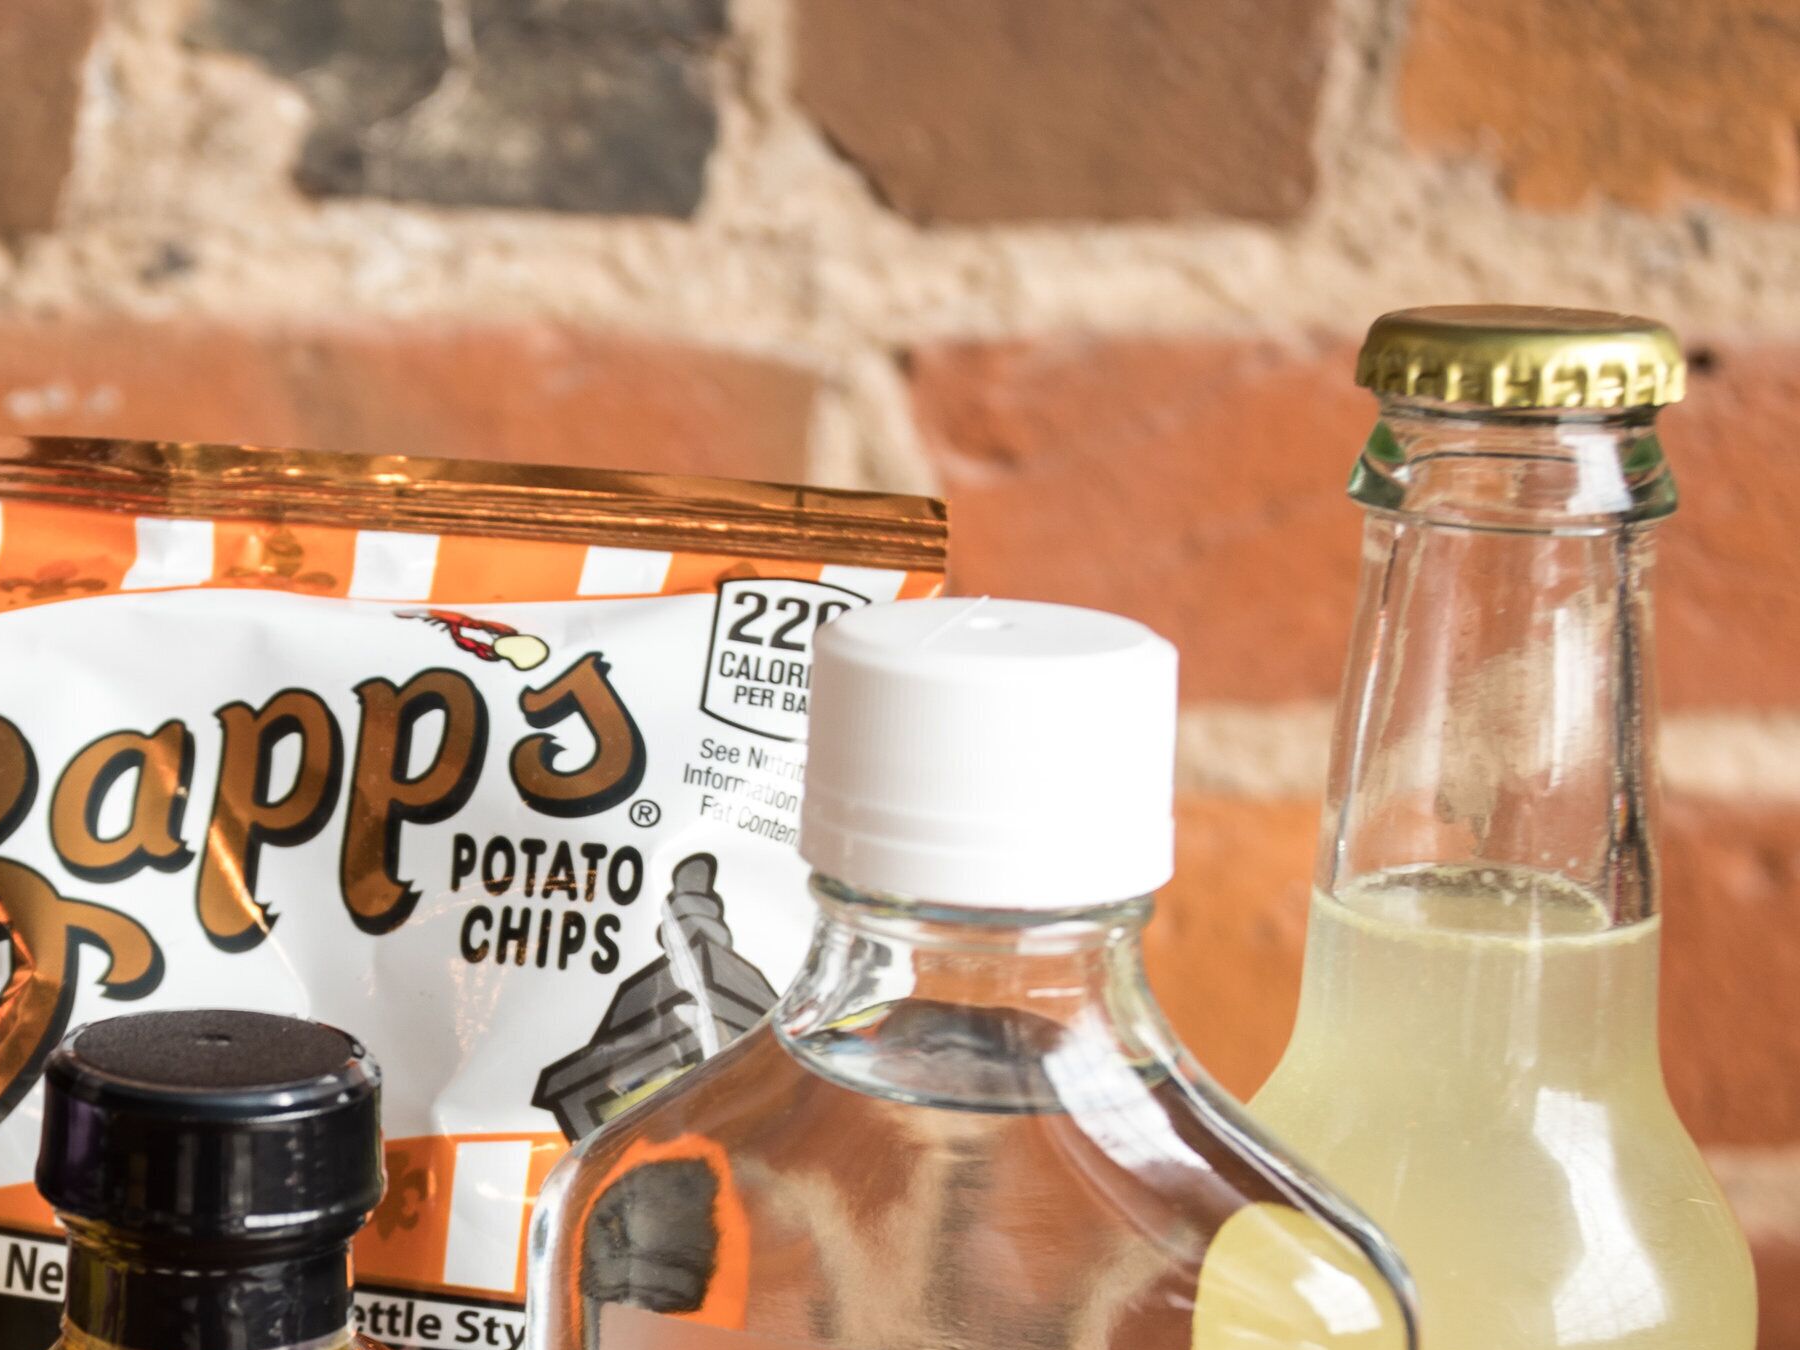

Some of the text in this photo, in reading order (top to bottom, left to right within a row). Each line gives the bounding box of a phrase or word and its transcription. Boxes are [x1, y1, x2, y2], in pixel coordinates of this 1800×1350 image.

[719, 651, 812, 690] CALORI
[733, 685, 808, 716] PER BA
[699, 739, 740, 765] See
[737, 806, 800, 848] Conten
[449, 831, 645, 907] POTATO
[460, 905, 623, 976] CHIPS
[4, 1242, 64, 1296] Ne
